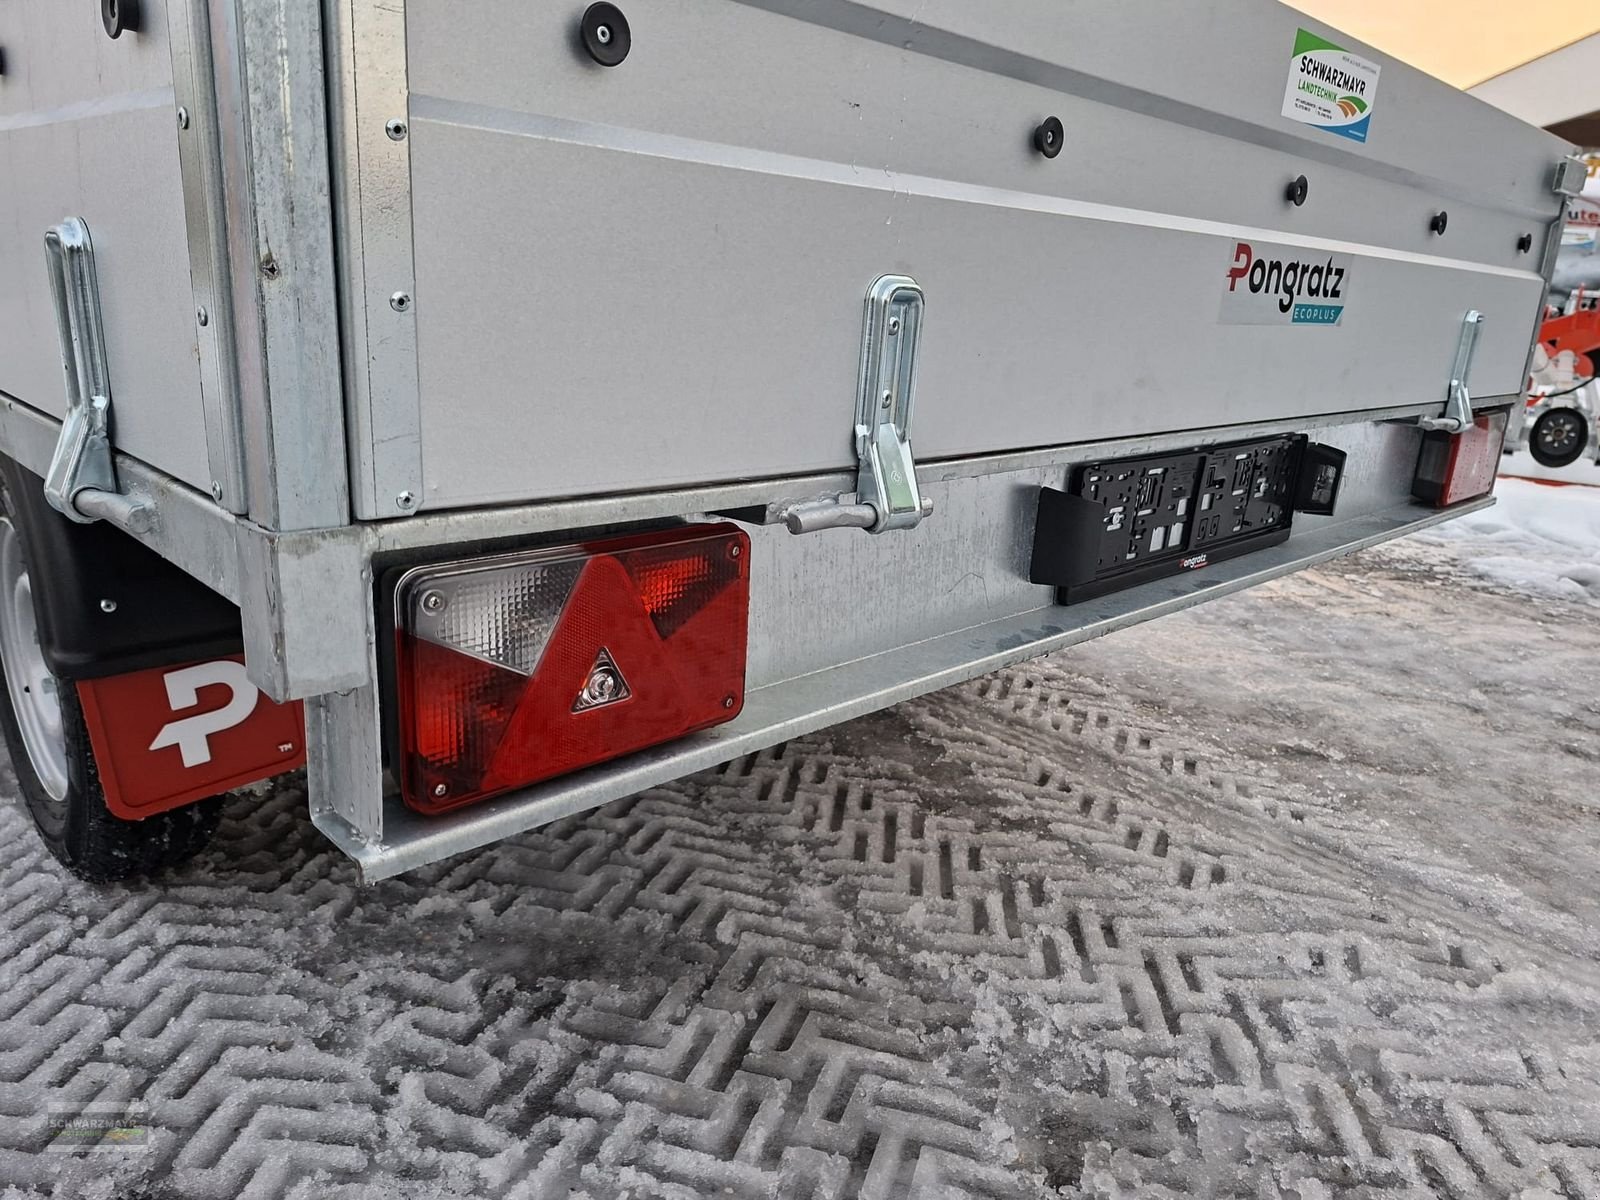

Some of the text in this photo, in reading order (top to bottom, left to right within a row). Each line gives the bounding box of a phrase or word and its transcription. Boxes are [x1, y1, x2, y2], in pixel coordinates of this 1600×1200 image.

[1297, 79, 1338, 103] LANDTECHNIK
[1300, 55, 1366, 96] SCHWARZMAYR
[1226, 242, 1345, 313] Pongratz
[1294, 308, 1335, 320] ECOPLUS
